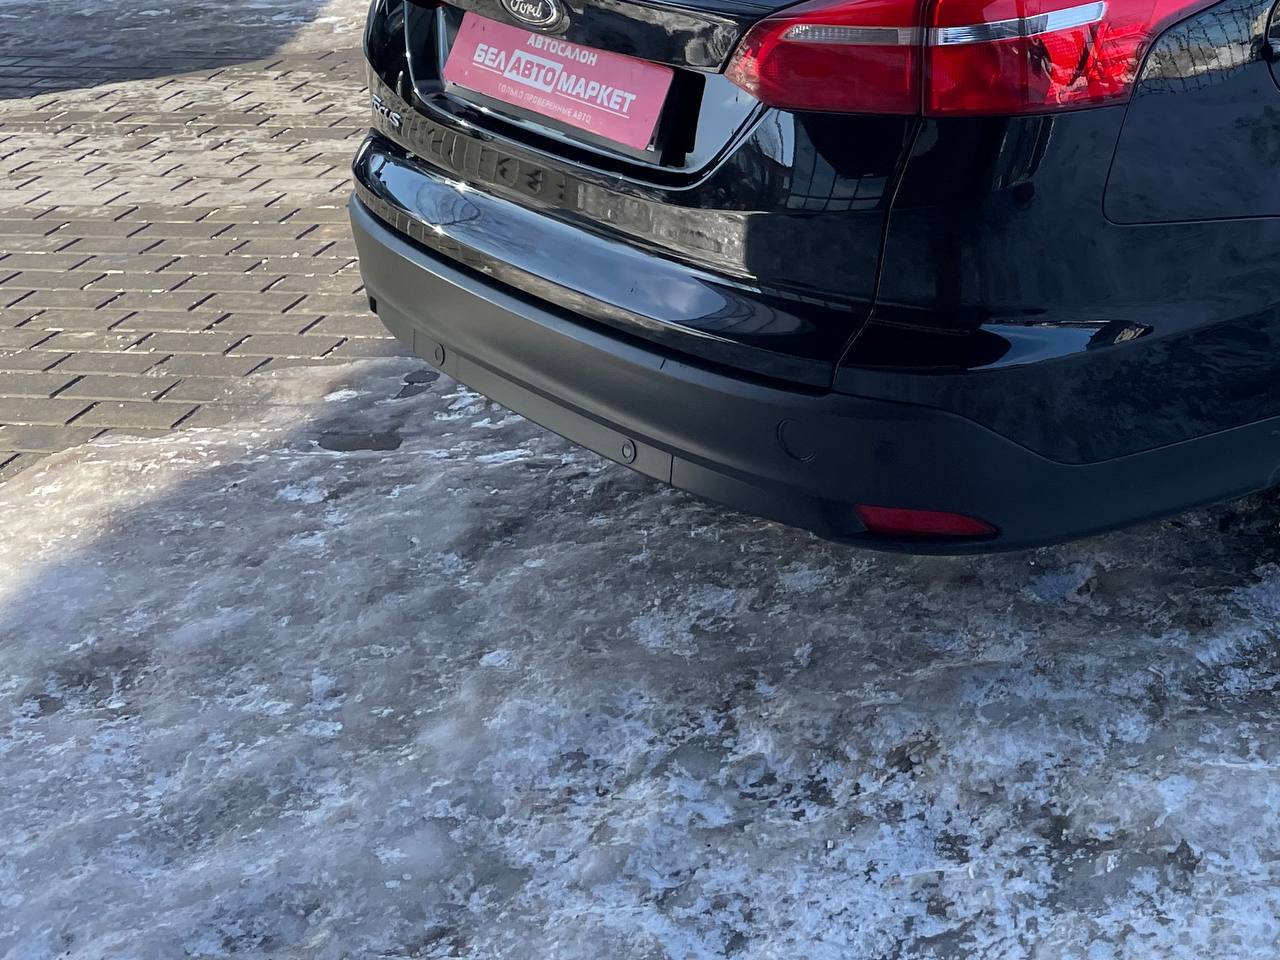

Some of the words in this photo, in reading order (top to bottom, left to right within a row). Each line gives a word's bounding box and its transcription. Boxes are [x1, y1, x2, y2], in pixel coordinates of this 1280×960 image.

[526, 33, 599, 66] АВТОСАЛОН
[524, 91, 574, 117] ПРОВЕРЕННЫЕ
[573, 109, 592, 124] АВТО
